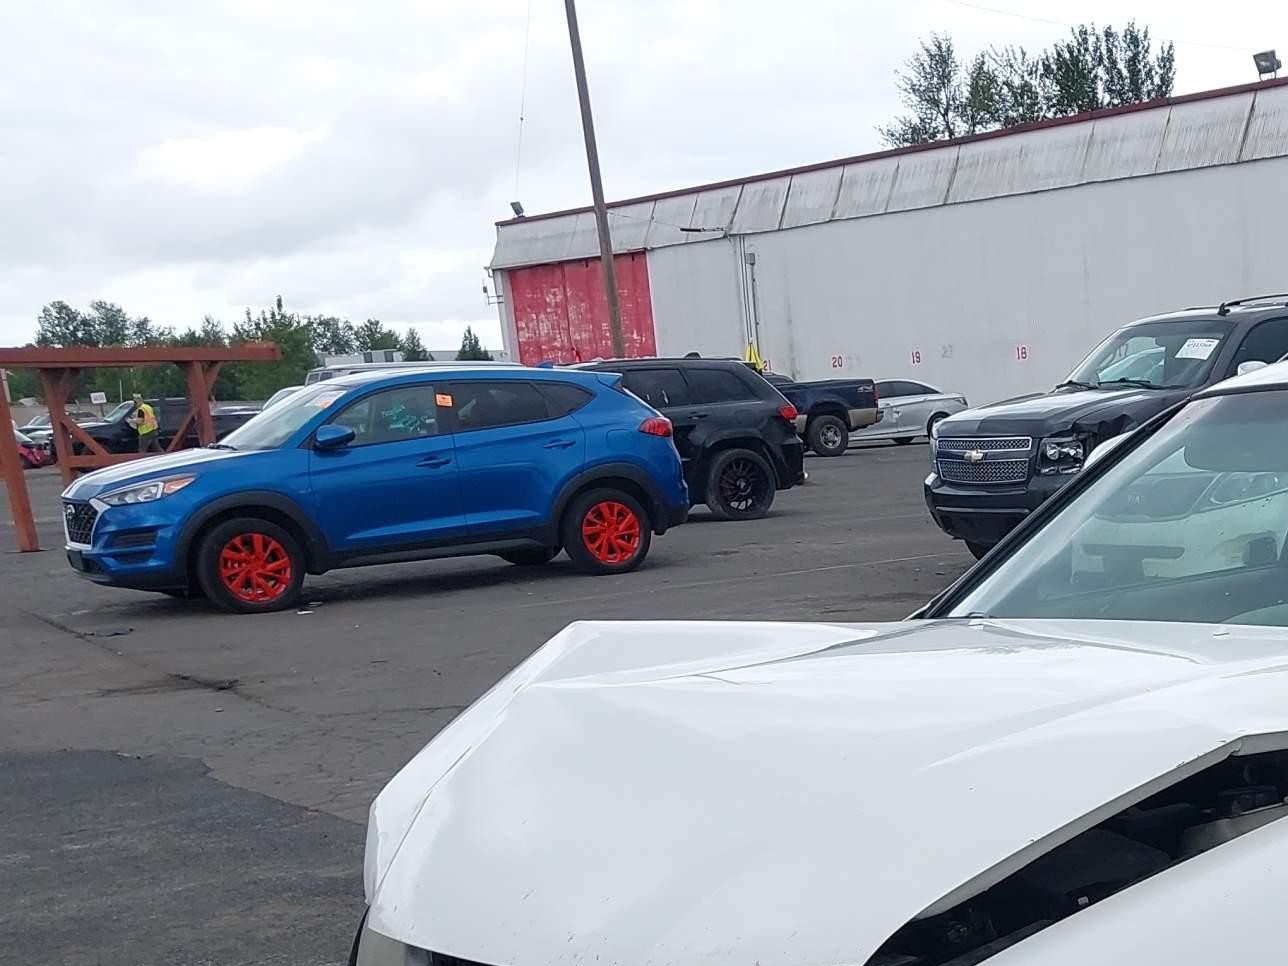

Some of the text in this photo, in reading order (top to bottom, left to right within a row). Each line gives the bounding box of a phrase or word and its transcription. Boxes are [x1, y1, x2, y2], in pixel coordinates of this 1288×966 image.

[911, 351, 921, 364] 19
[1016, 346, 1028, 360] 18
[831, 355, 843, 368] 20
